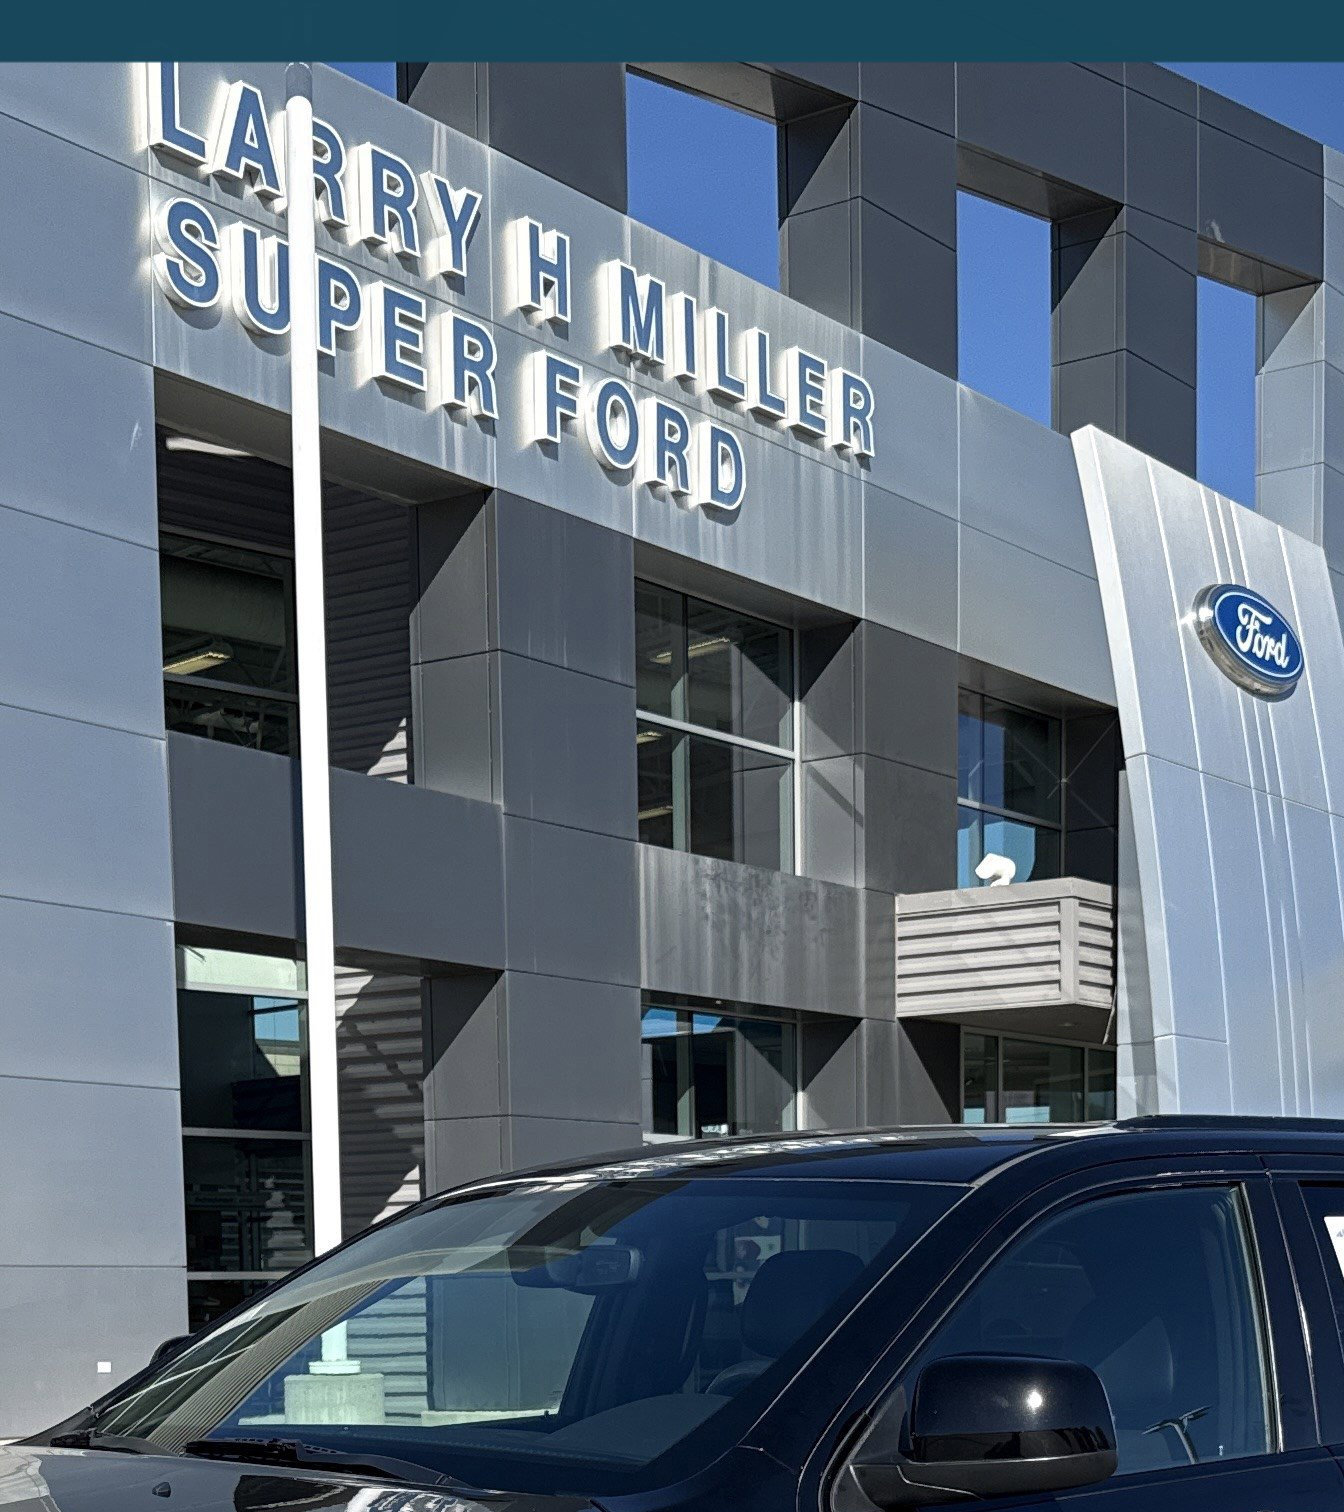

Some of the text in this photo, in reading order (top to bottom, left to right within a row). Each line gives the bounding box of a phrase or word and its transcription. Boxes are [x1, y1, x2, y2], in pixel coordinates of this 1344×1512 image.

[149, 61, 876, 459] LARRY H MILLER
[152, 196, 747, 513] SUPER FORD
[1235, 602, 1290, 669] Ford
